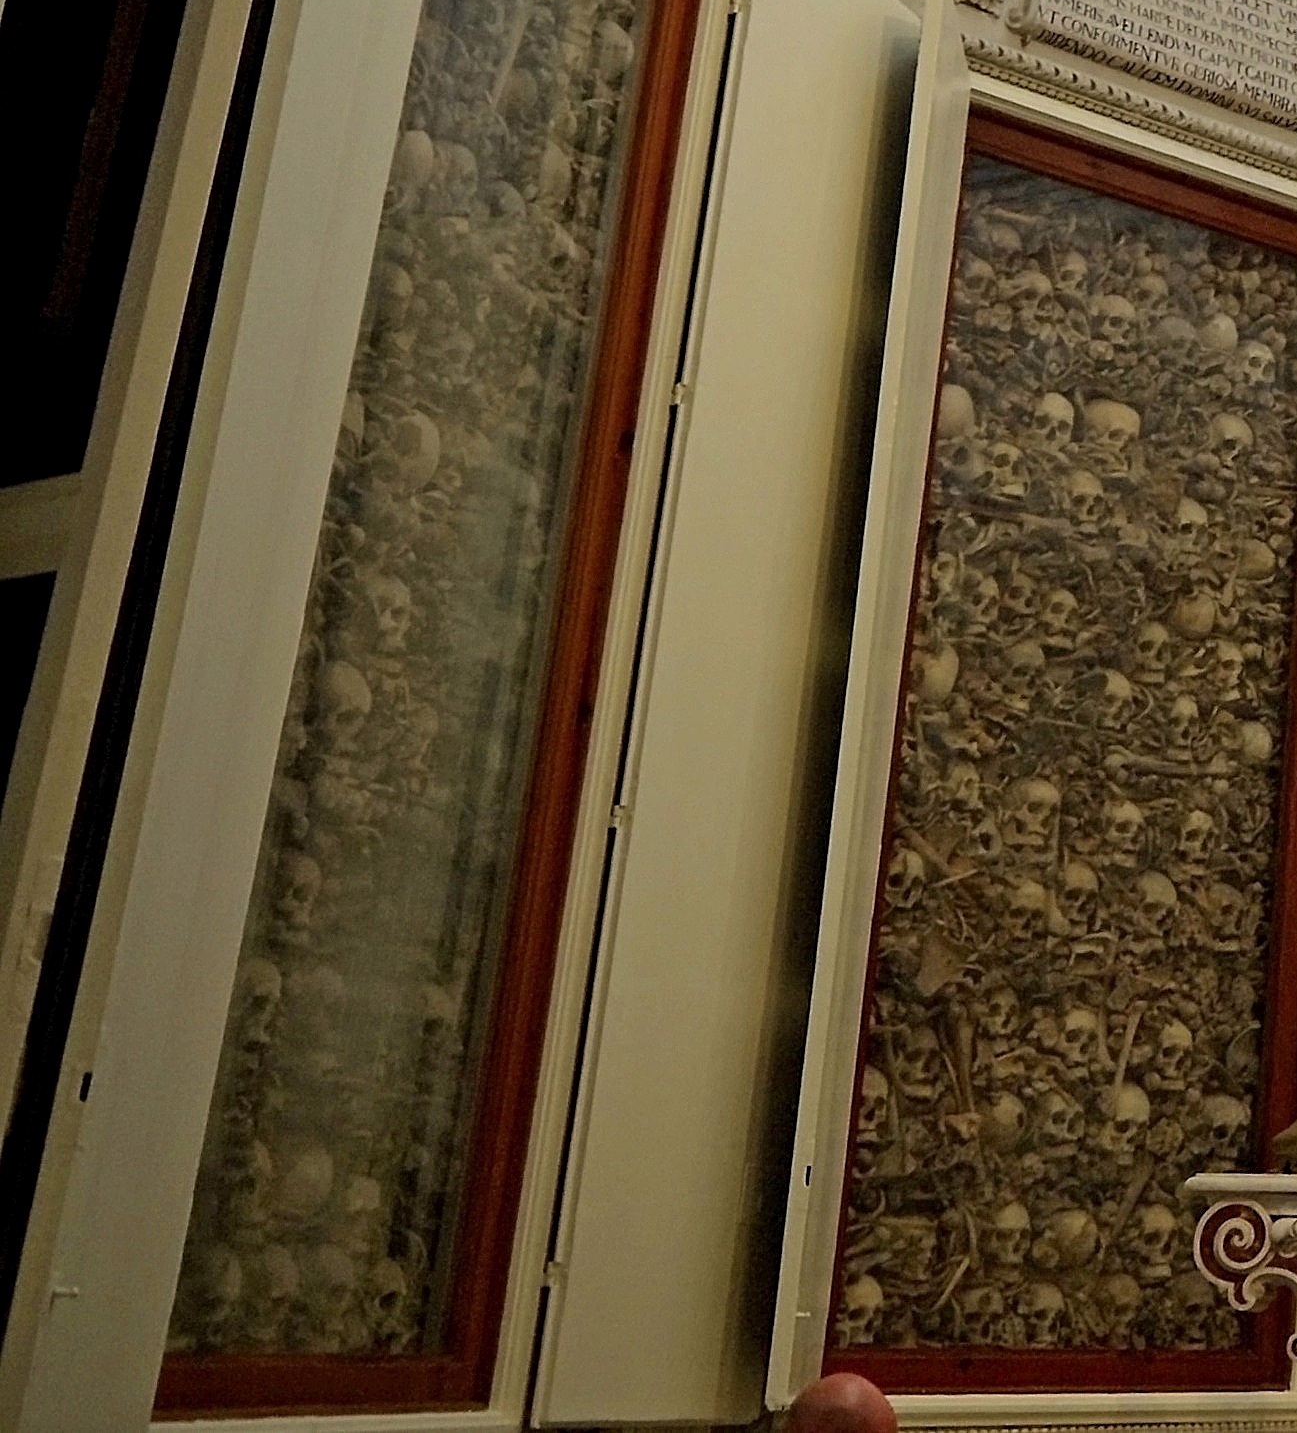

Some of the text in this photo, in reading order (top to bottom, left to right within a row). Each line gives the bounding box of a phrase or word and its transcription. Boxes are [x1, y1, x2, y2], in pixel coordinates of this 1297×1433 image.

[1225, 3, 1243, 22] AD
[1037, 5, 1059, 27] VT
[1244, 82, 1296, 115] MEMBRA
[1250, 46, 1274, 67] PRO
[1275, 55, 1297, 76] FIDE
[1244, 62, 1287, 92] CAPITI
